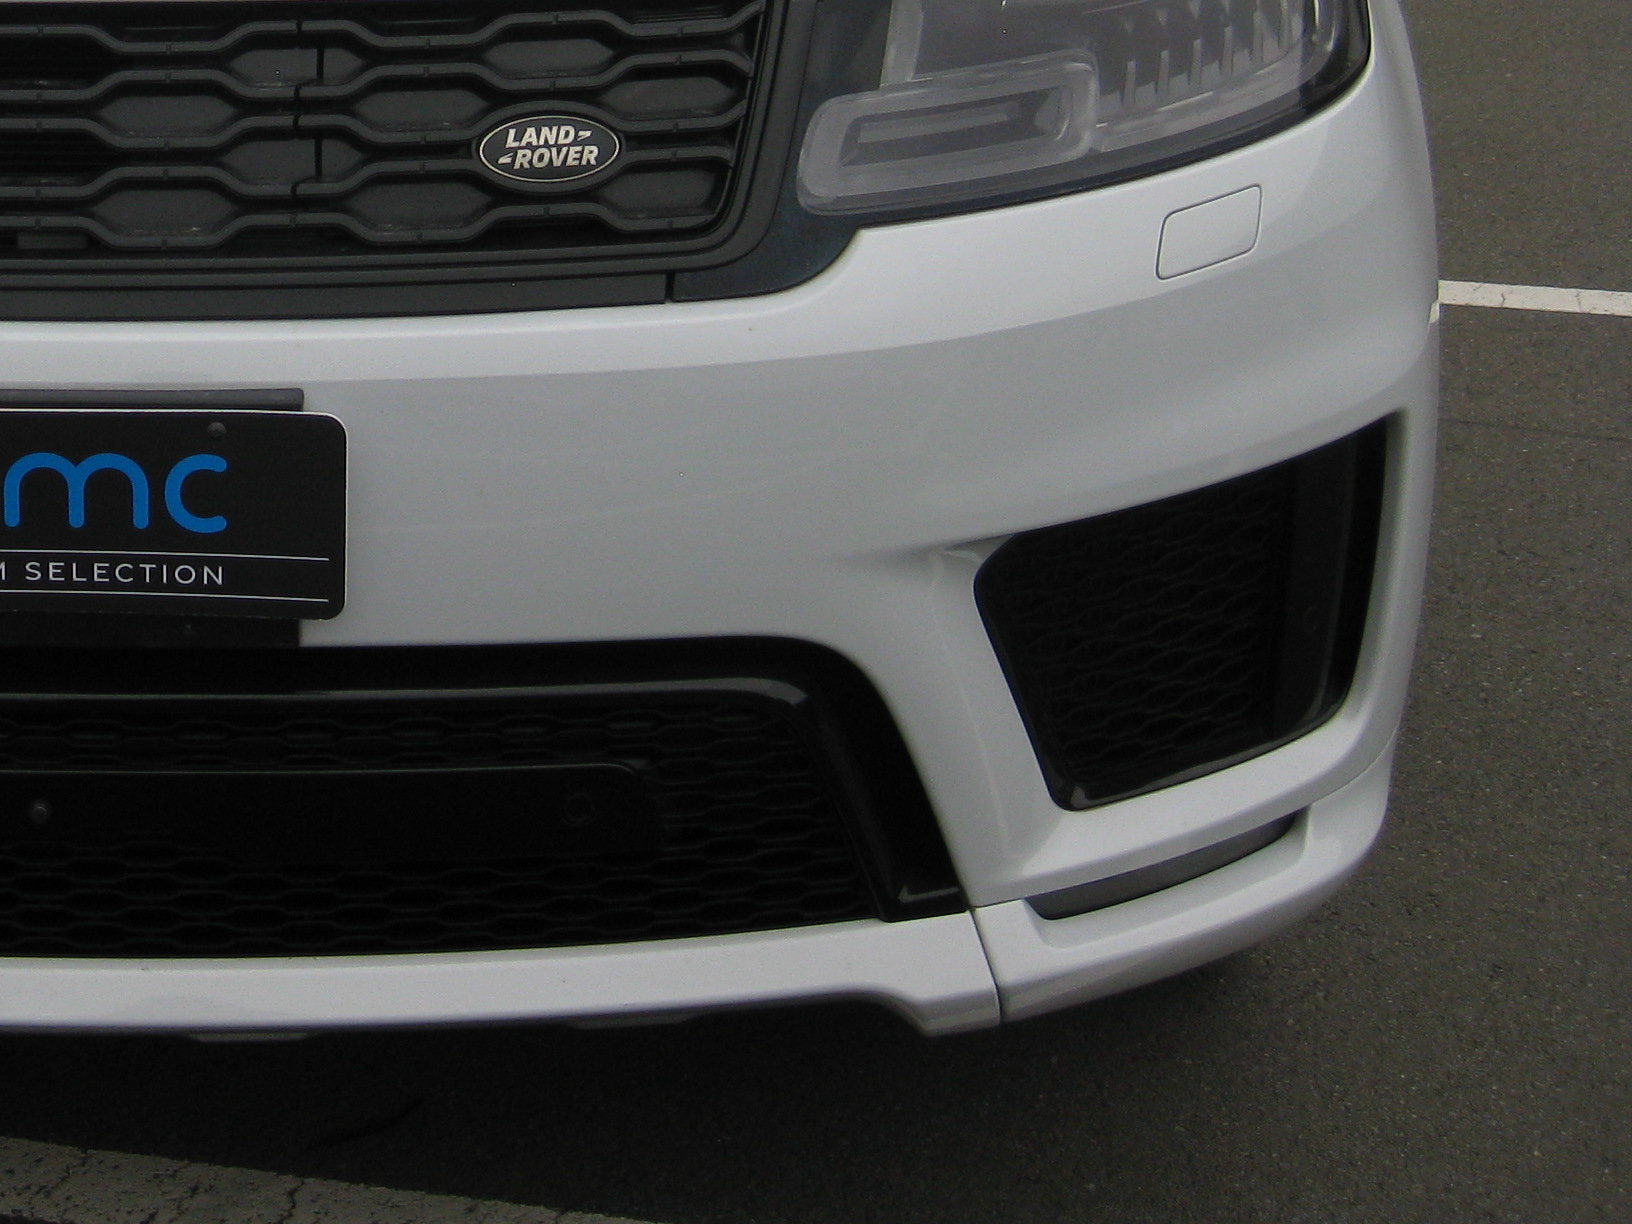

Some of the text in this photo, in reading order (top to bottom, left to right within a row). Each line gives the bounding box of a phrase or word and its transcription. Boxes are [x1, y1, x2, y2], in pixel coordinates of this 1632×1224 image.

[505, 125, 575, 149] LAND
[513, 145, 599, 170] ROVER
[25, 561, 224, 586] SELECTION
